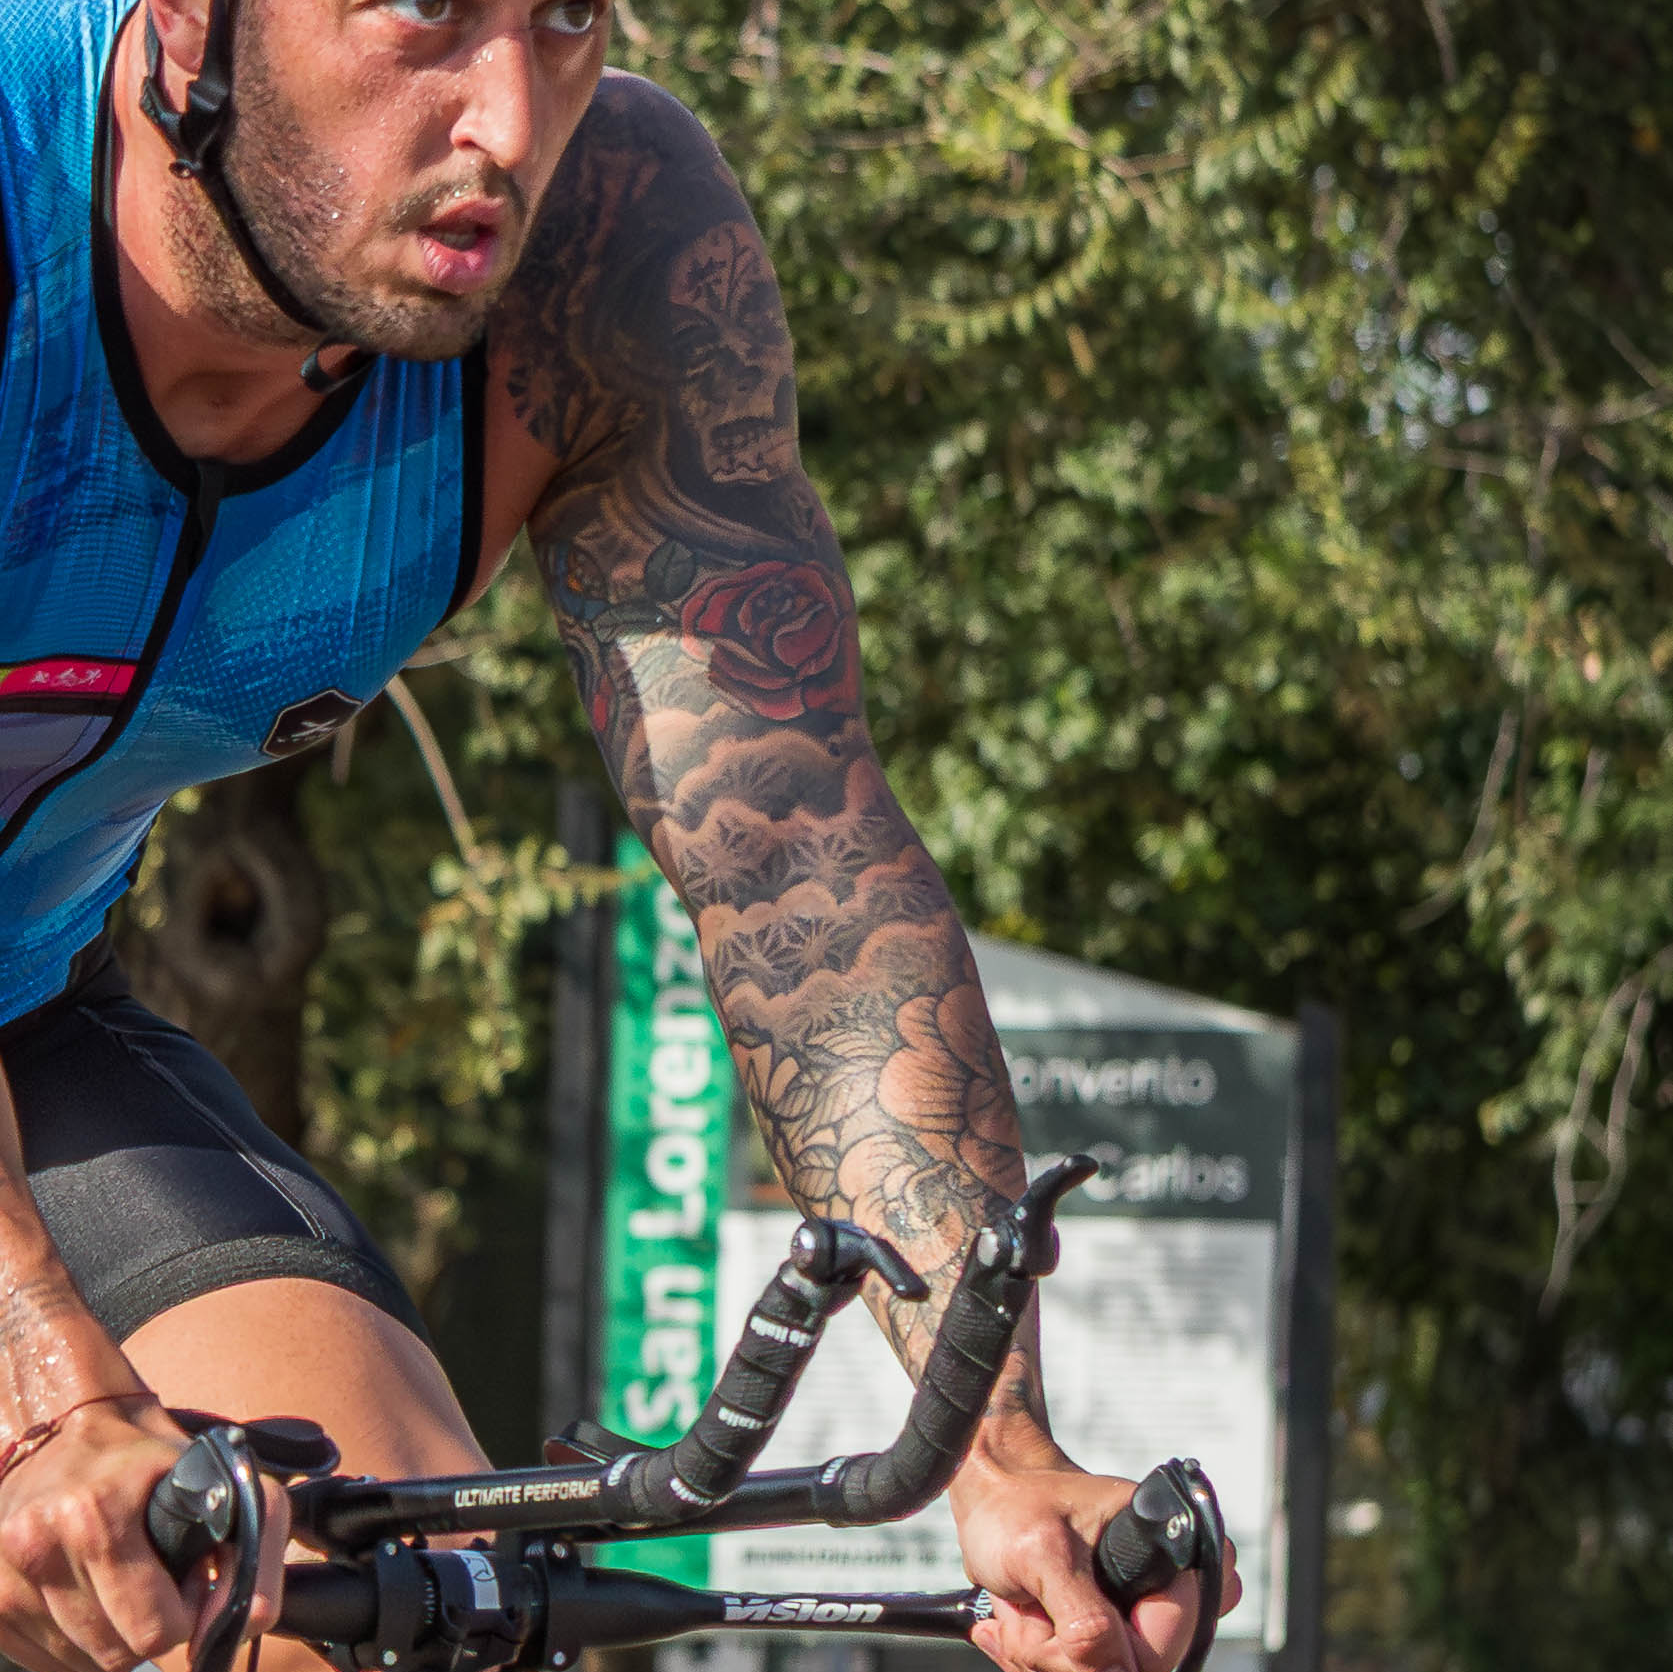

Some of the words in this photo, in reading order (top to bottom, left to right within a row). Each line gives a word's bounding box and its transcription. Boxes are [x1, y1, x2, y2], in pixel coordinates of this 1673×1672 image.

[1000, 1055, 1217, 1106] onvento
[626, 1263, 704, 1435] San
[454, 1485, 521, 1508] ULTIMATE
